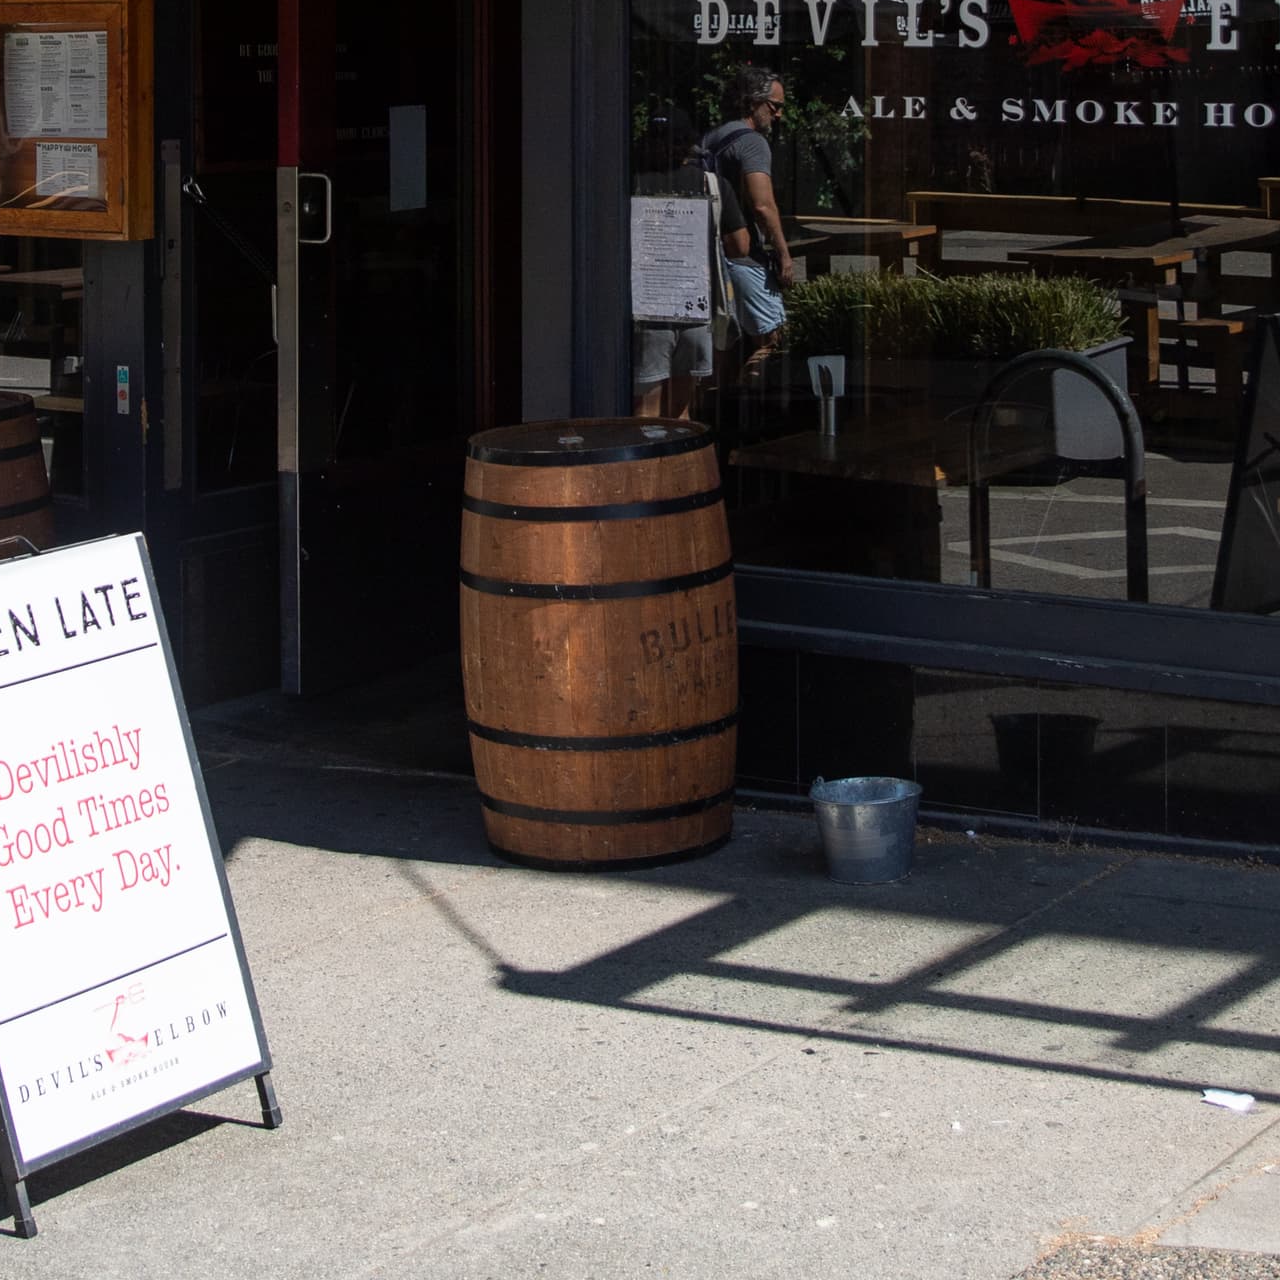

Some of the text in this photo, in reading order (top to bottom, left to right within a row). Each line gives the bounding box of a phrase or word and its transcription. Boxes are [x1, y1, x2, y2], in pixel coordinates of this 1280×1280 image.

[840, 95, 928, 122] ALE
[949, 95, 982, 122] &
[1000, 97, 1180, 127] SMOKE
[54, 577, 149, 640] LATE
[77, 781, 172, 840] Times
[5, 843, 183, 930] Every Day.
[17, 1000, 229, 1104] DEVIL'S ELBOW
